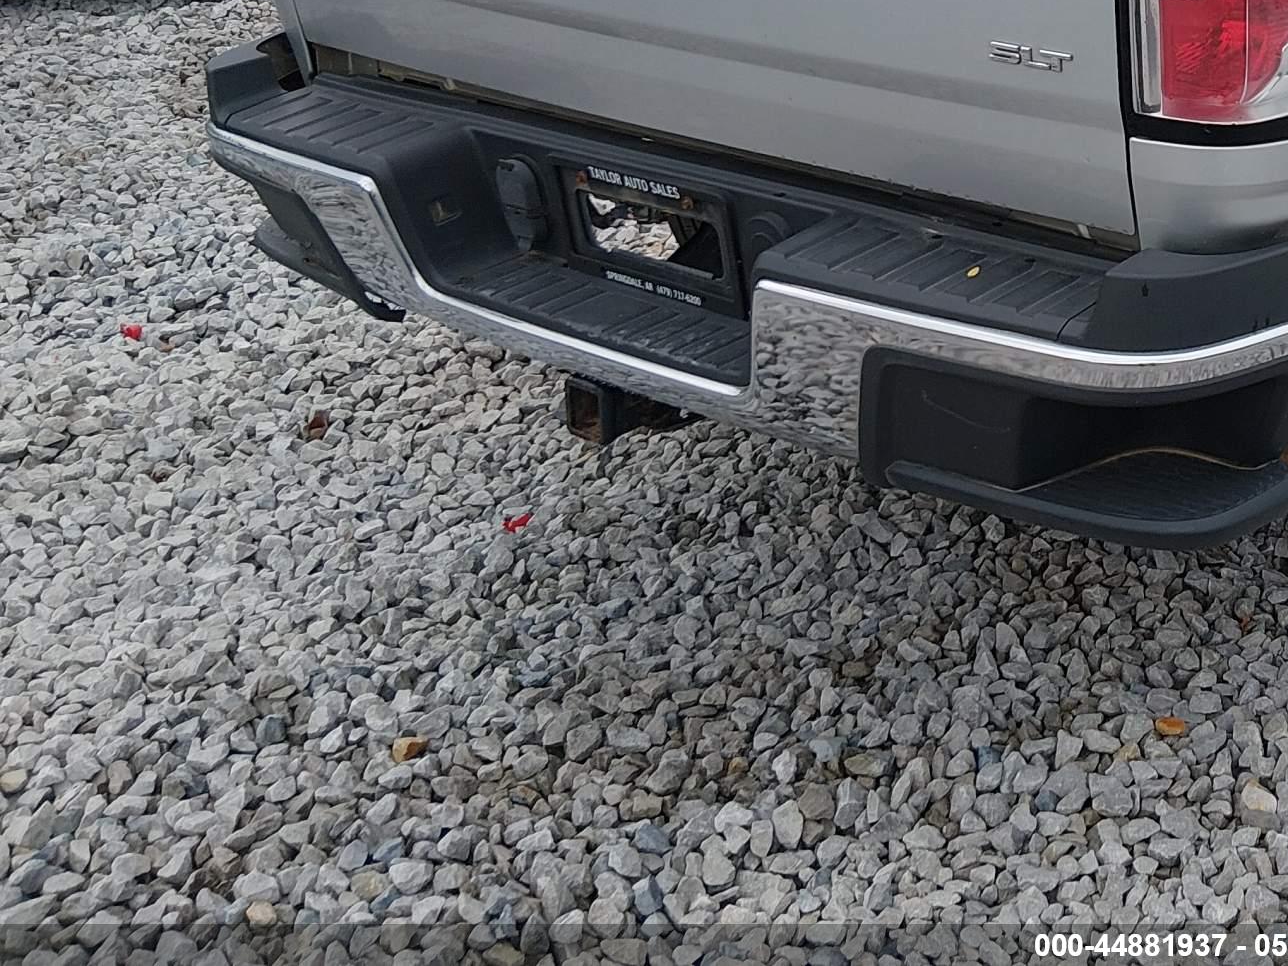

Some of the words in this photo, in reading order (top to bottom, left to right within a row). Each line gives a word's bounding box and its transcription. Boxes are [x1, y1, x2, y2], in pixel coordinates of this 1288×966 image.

[988, 40, 1074, 73] SLT
[587, 166, 623, 186] TAYLOR
[623, 175, 649, 192] AUTO
[649, 181, 681, 199] SALES
